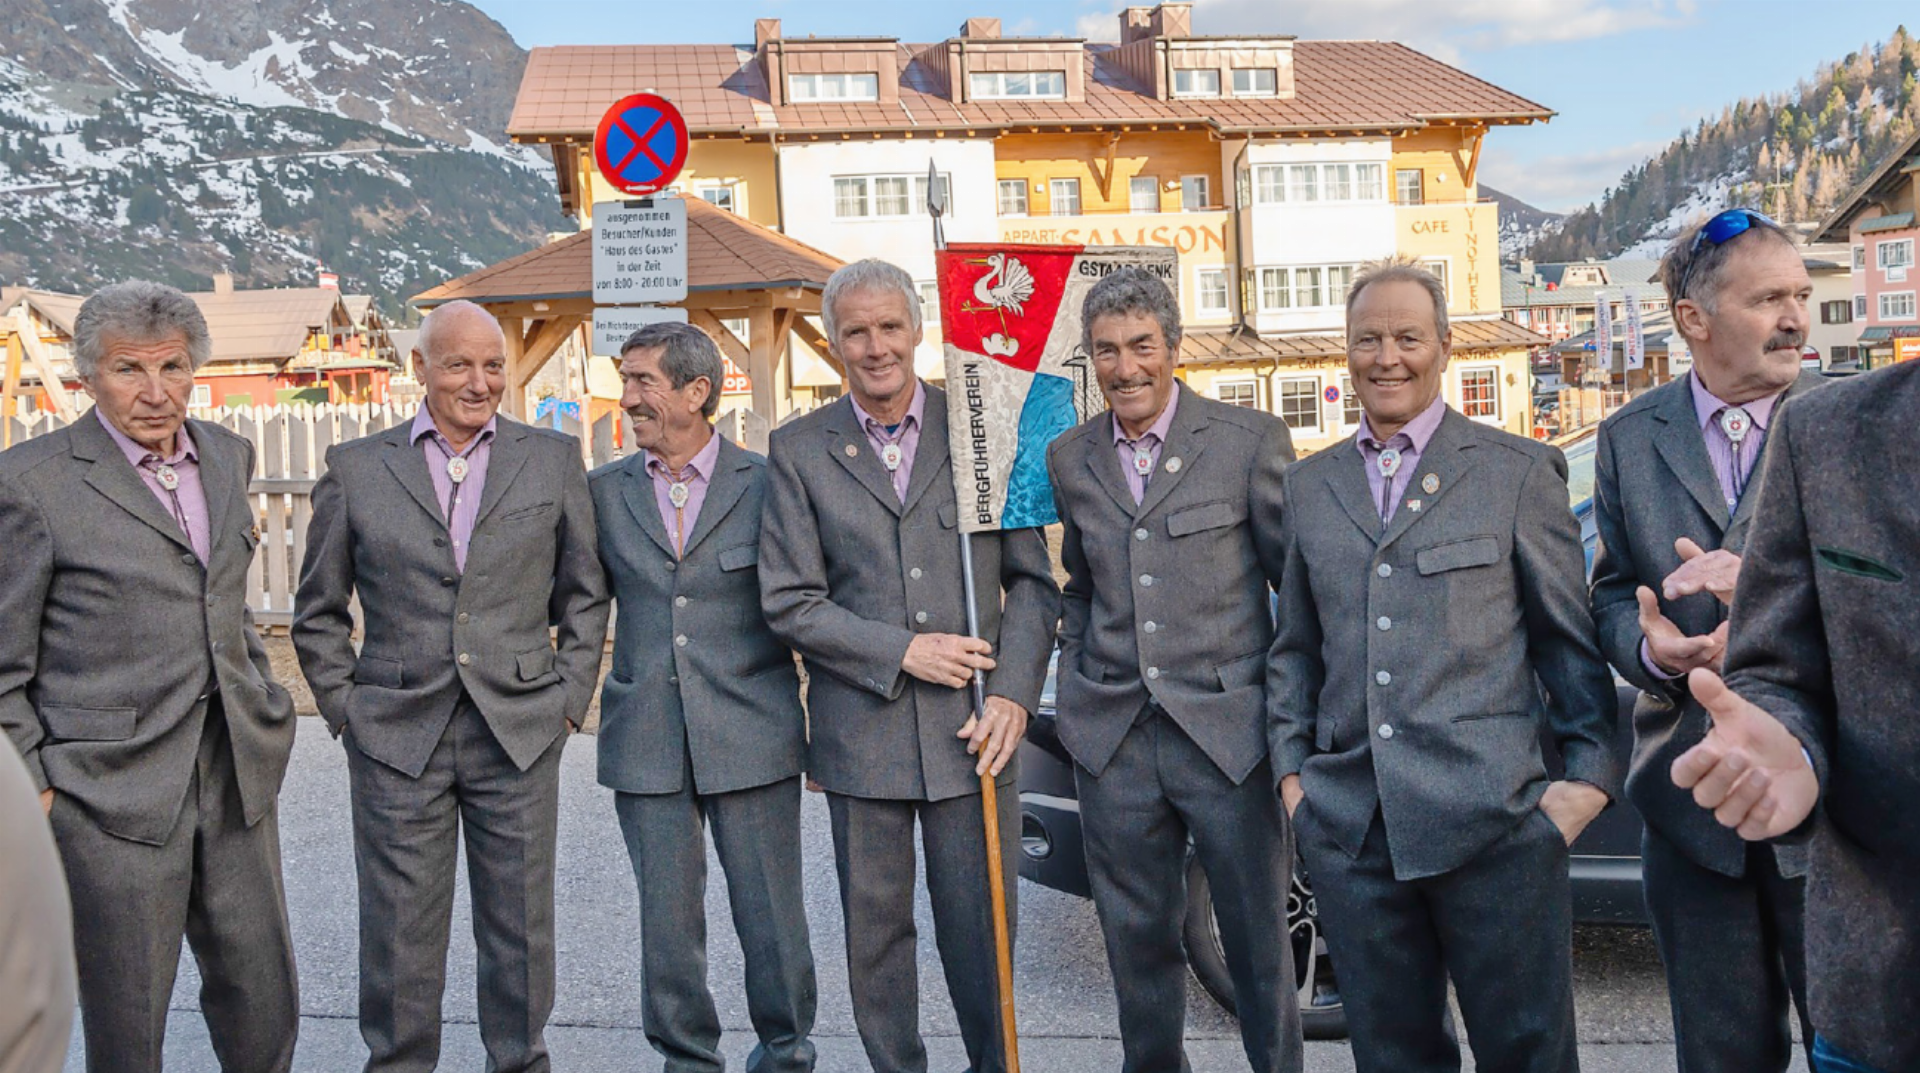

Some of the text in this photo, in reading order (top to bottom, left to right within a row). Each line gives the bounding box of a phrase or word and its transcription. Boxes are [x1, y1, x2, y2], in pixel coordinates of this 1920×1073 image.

[607, 212, 670, 224] ausgenommen
[601, 226, 676, 239] Besucher/Kunden
[1411, 220, 1449, 234] CAFE
[1061, 225, 1226, 254] SAMSON
[628, 245, 643, 255] des
[1465, 207, 1479, 310] VINOTHEK
[616, 260, 661, 272] in der Zeit
[596, 280, 612, 289] von
[614, 278, 633, 289] 8:00
[641, 277, 664, 288] 20:00
[666, 277, 683, 287] Uhr
